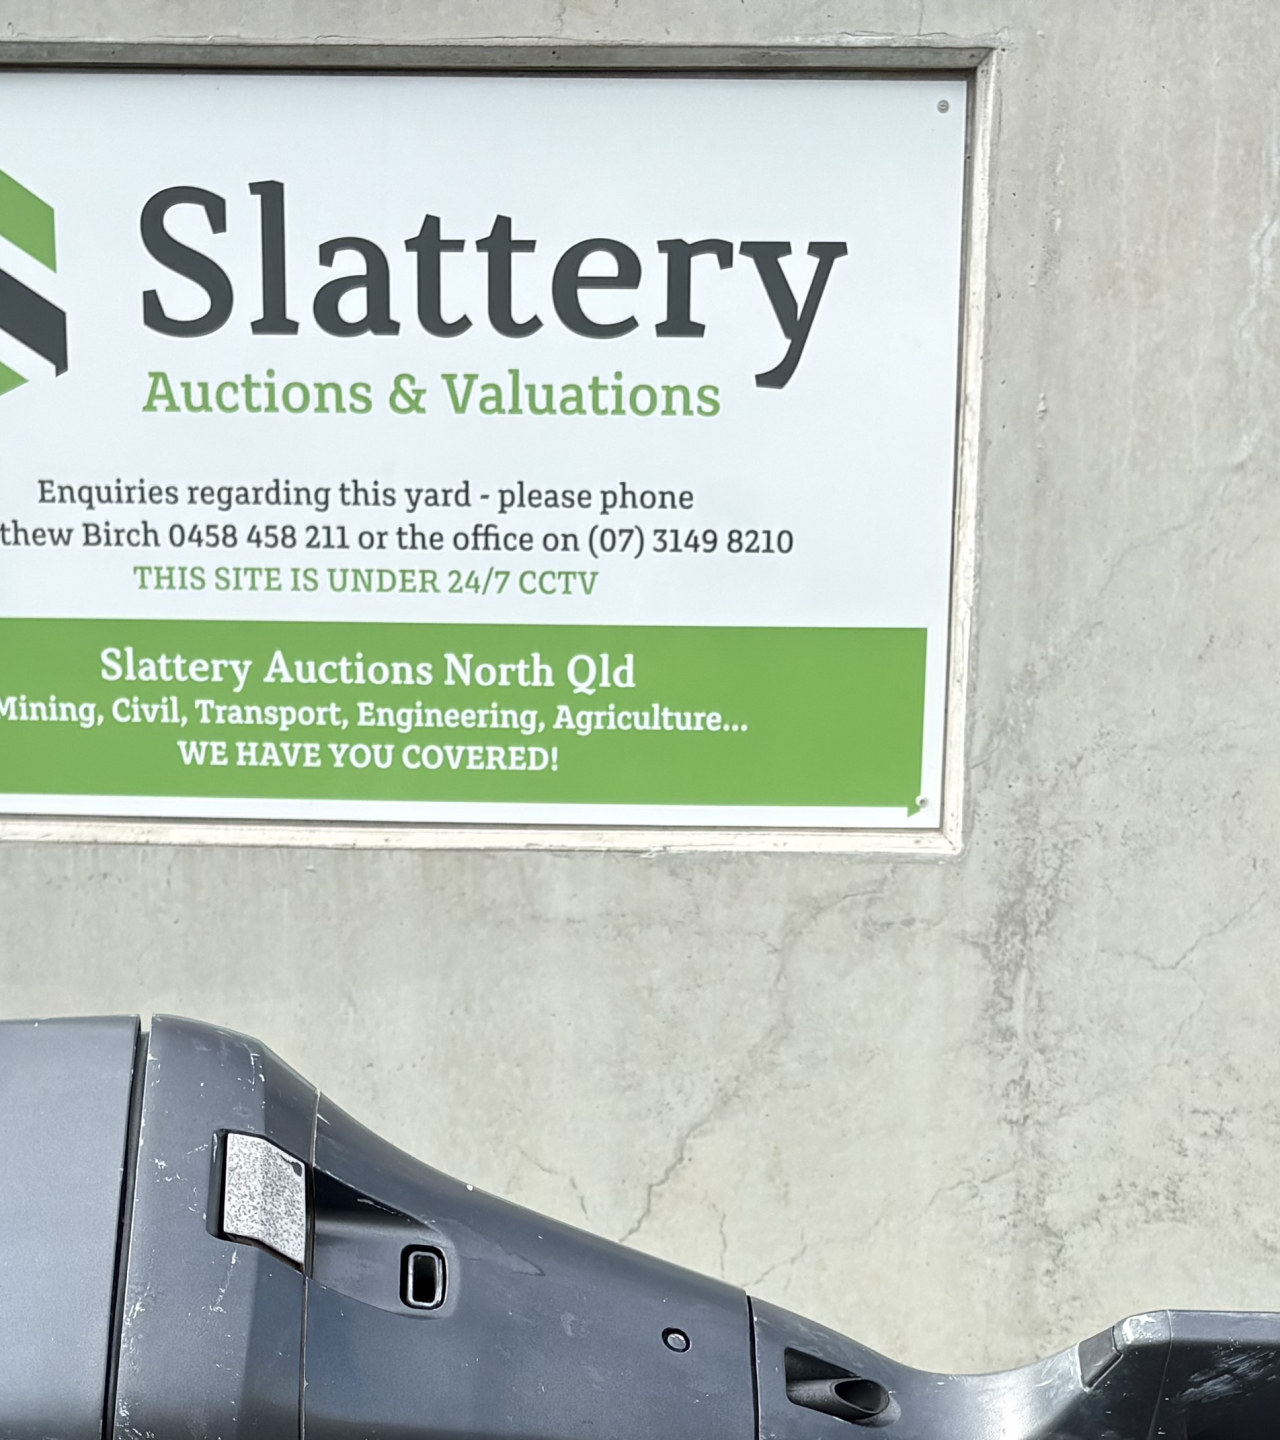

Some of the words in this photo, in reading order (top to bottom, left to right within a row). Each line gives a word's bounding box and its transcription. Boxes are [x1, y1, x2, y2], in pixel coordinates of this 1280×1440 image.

[139, 179, 849, 391] Slattery
[141, 367, 373, 415] Auctions
[388, 372, 428, 415] &
[440, 368, 721, 418] Valuations
[36, 476, 180, 512] Enquiries
[186, 477, 332, 514] regarding
[337, 478, 397, 508] this
[403, 479, 473, 514] yard
[496, 479, 593, 515] please
[599, 480, 694, 516] phone
[81, 519, 162, 548] Birch
[168, 522, 239, 549] 0458
[245, 523, 298, 550] 458
[304, 524, 351, 550] 211
[357, 529, 389, 551] or
[395, 522, 445, 551] the
[452, 522, 535, 553] office
[541, 532, 581, 553] on
[587, 523, 645, 560] (07)
[652, 528, 719, 554] 3149
[726, 528, 795, 555] 8210
[132, 565, 207, 591] THIS
[214, 566, 283, 592] SITE
[290, 567, 319, 593] IS
[326, 567, 442, 594] UNDER
[447, 565, 511, 596] 24/7
[518, 569, 600, 596] CCTV
[100, 646, 253, 693] Slattery
[263, 649, 433, 686] Auctions
[443, 652, 555, 687] North
[567, 653, 636, 696] Qld
[111, 695, 188, 728] Civil,
[194, 699, 349, 732] Transport,
[356, 700, 546, 736] Engineering,
[176, 740, 229, 766] WE
[235, 741, 322, 768] HAVE
[327, 743, 395, 769] YOU
[401, 744, 558, 772] COVERED!
